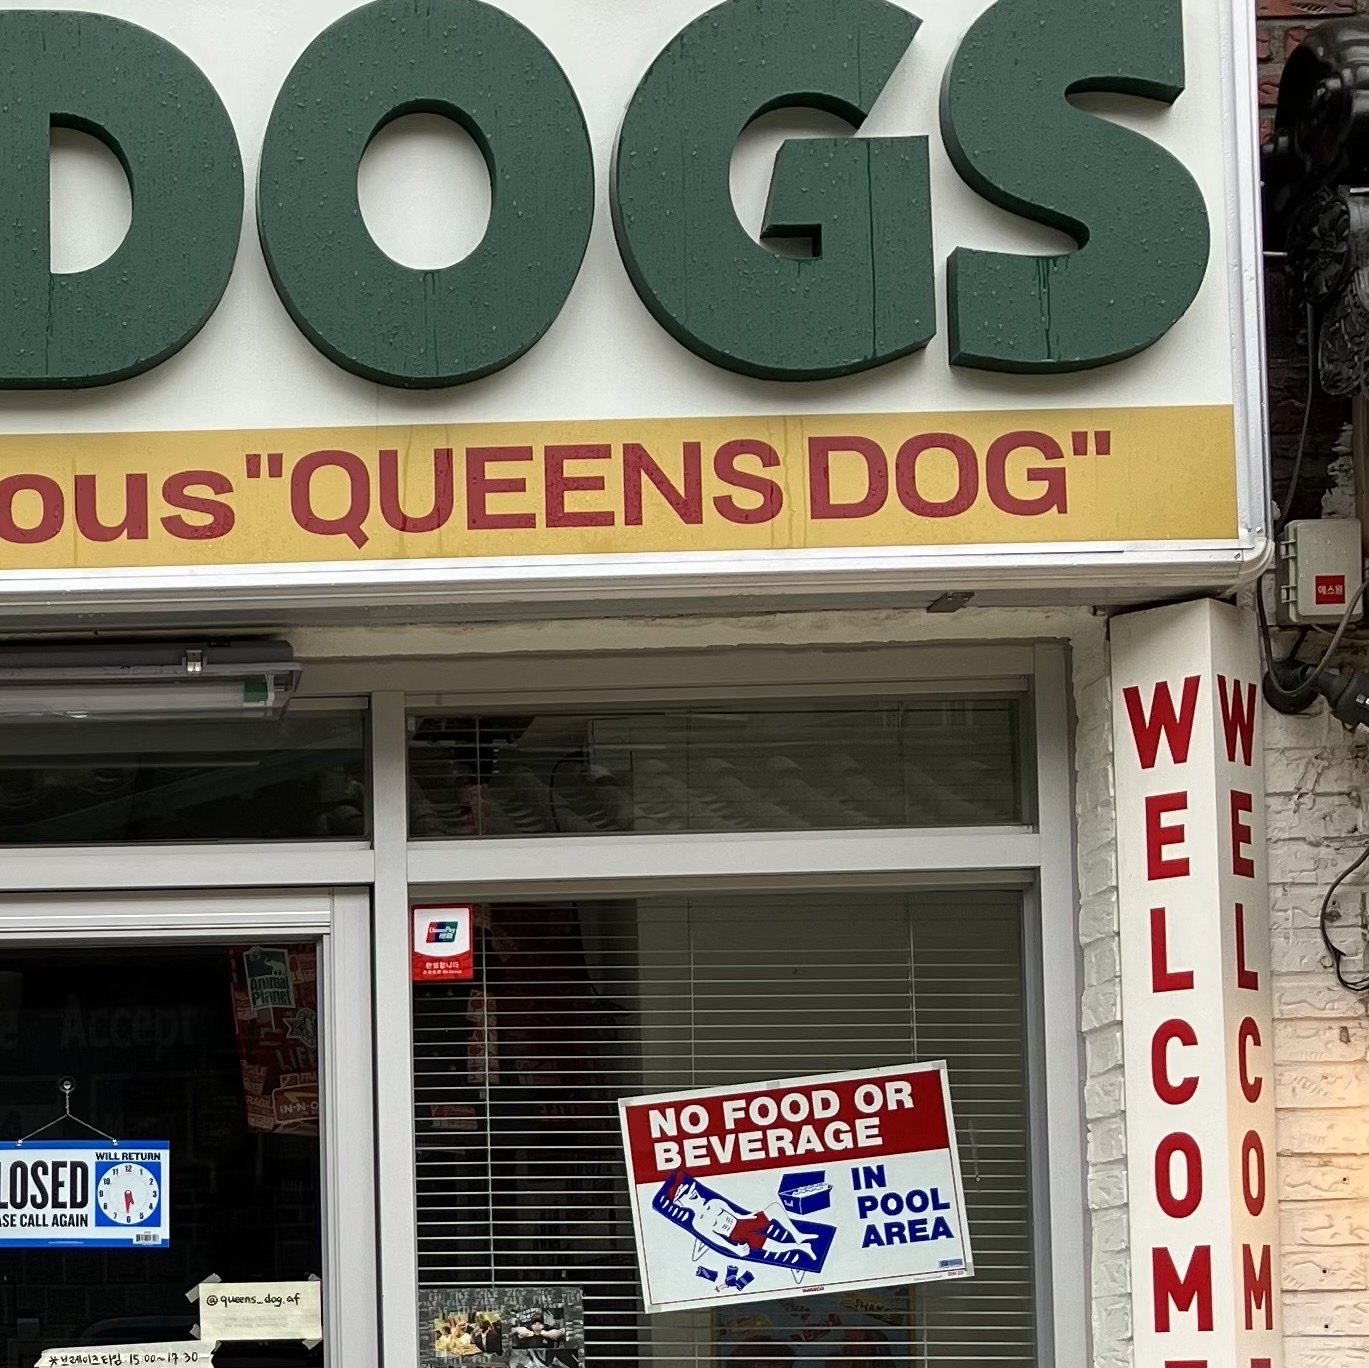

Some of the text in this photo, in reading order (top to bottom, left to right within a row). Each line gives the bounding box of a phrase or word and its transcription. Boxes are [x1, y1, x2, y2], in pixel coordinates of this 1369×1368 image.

[809, 430, 1112, 520] DOG"
[1317, 584, 1343, 595] 에스원
[648, 1081, 914, 1140] NO FOOD OR
[95, 1152, 161, 1160] WILL RETURN
[654, 1117, 884, 1172] BEVERAGE
[850, 1165, 886, 1191] IN
[858, 1187, 951, 1220] POOL
[20, 1213, 48, 1227] CALL
[51, 1213, 88, 1227] AGAIN
[862, 1217, 955, 1249] AREA
